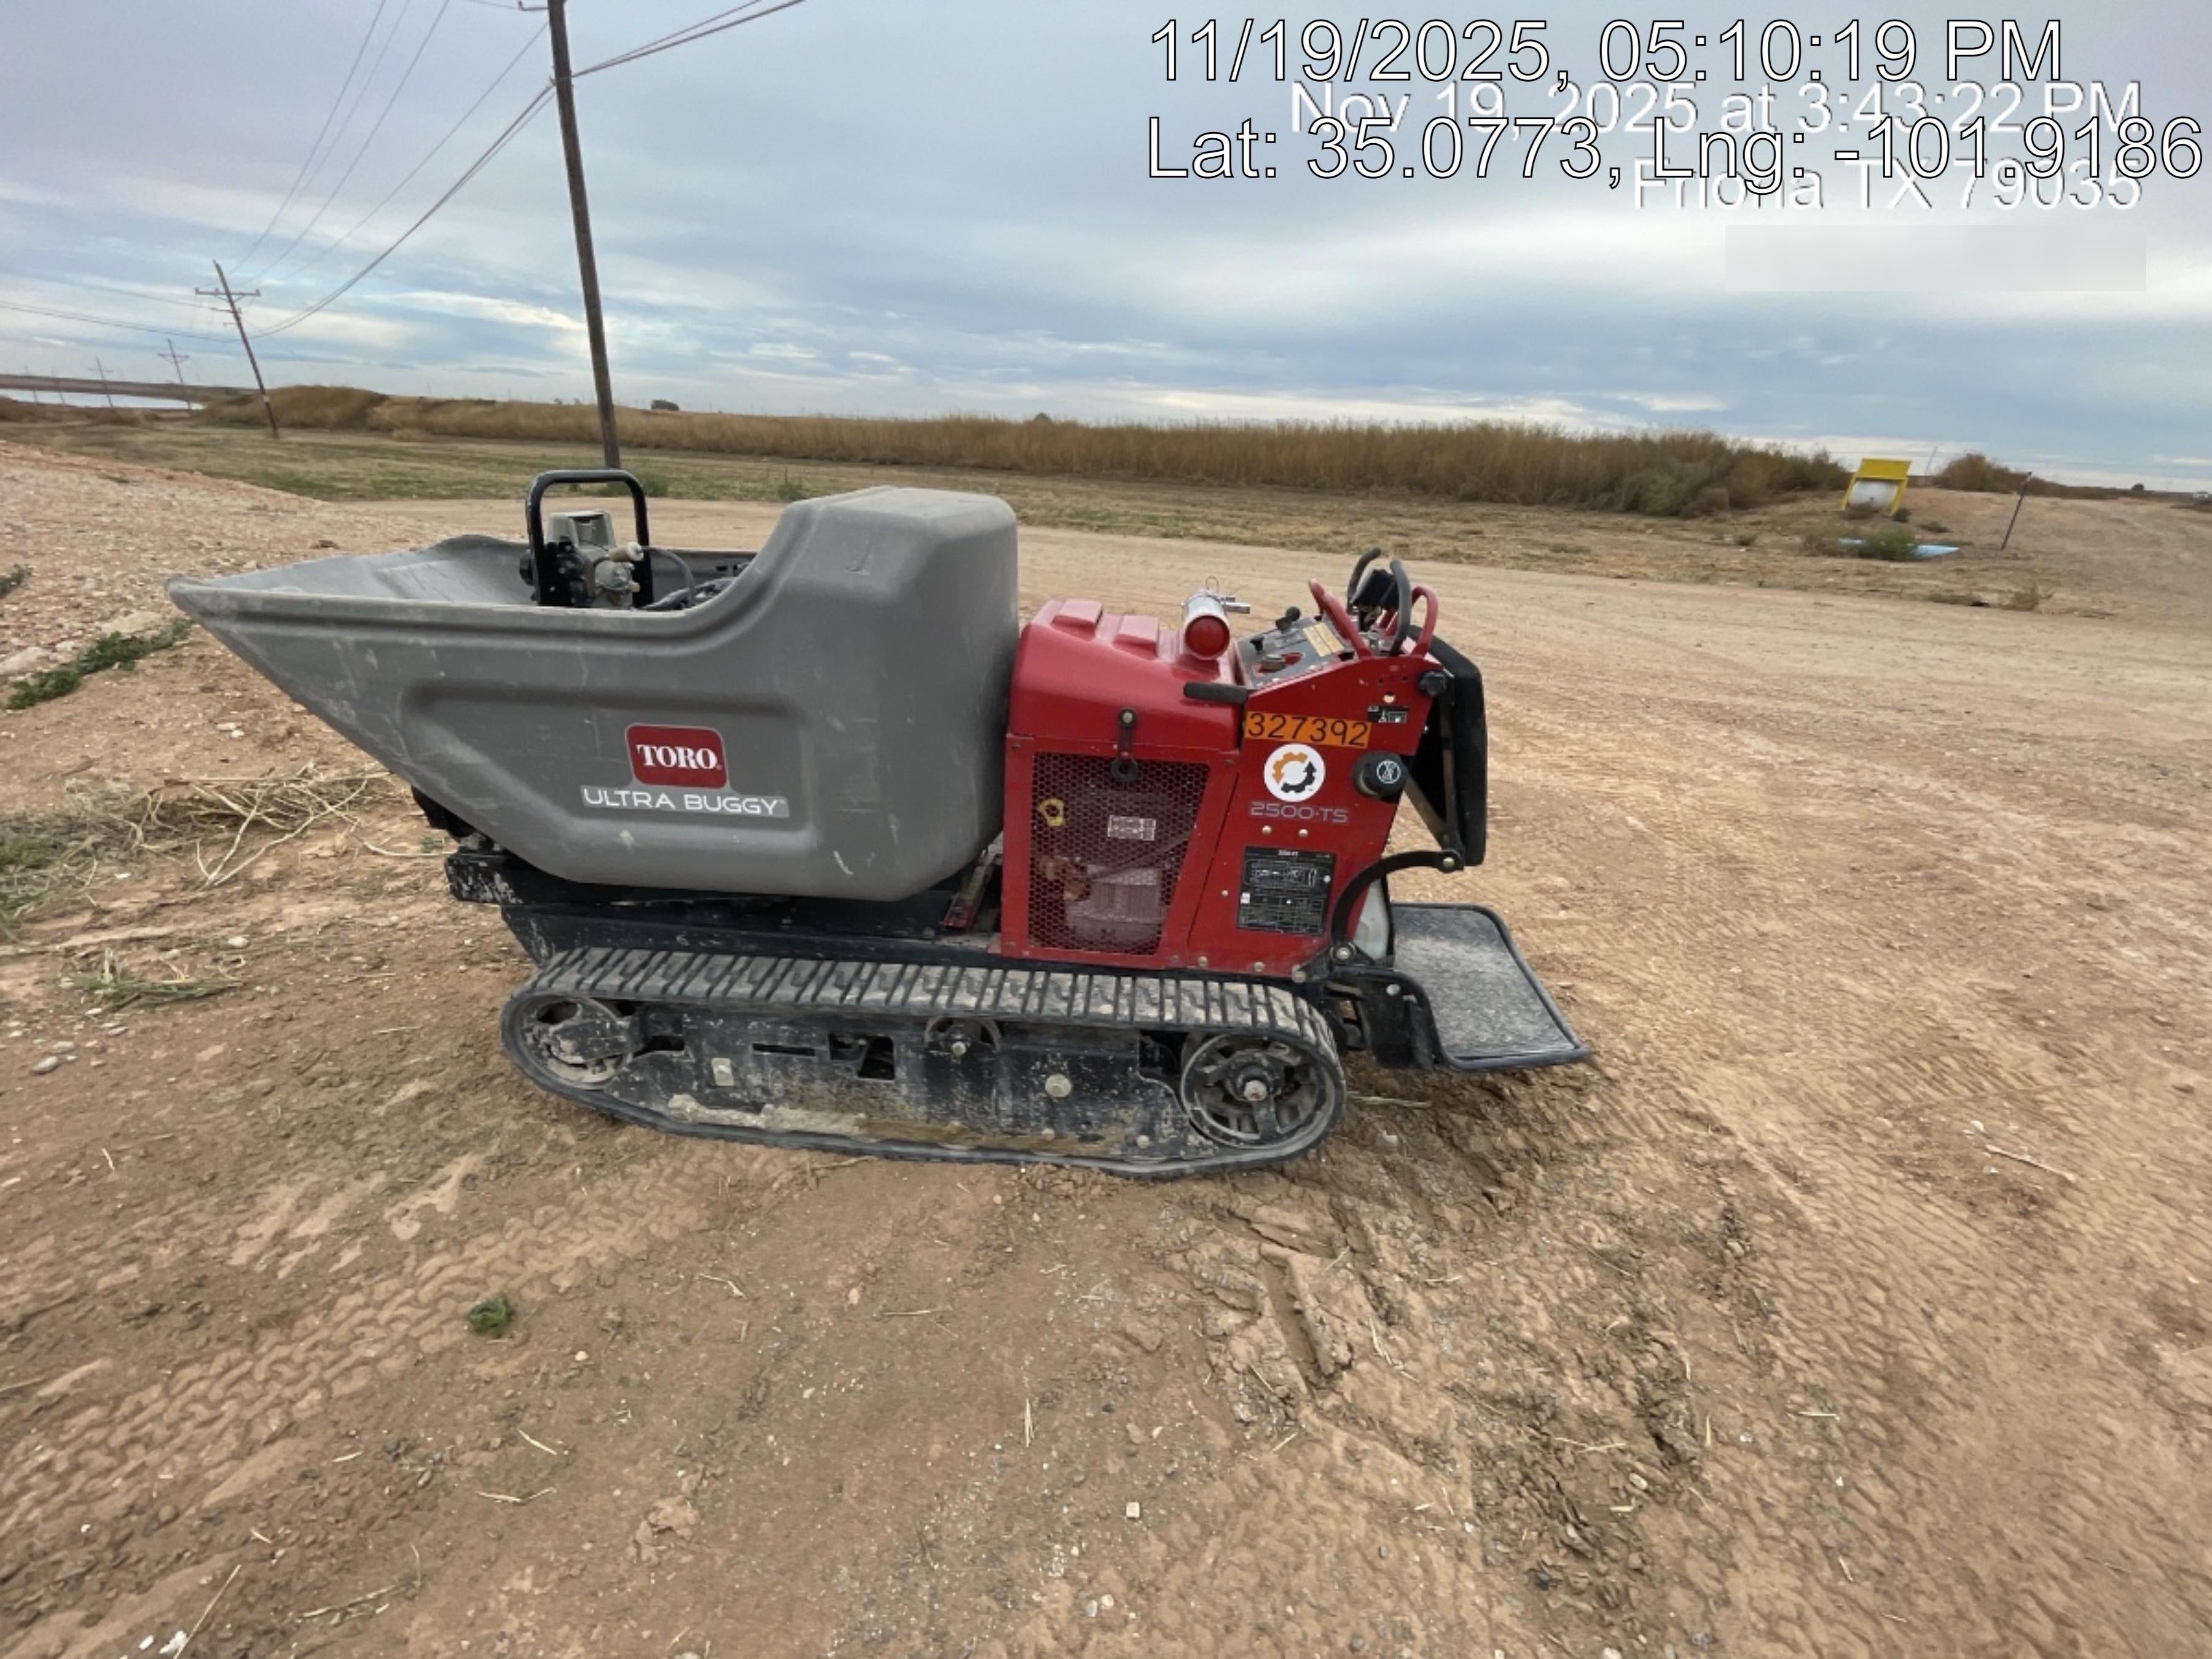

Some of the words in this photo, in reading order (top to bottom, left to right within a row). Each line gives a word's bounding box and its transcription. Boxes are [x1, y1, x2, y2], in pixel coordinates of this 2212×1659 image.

[1247, 712, 1369, 746] 327392
[635, 744, 719, 770] TORO
[583, 788, 675, 810] ULTRA
[683, 793, 779, 815] BUGGY
